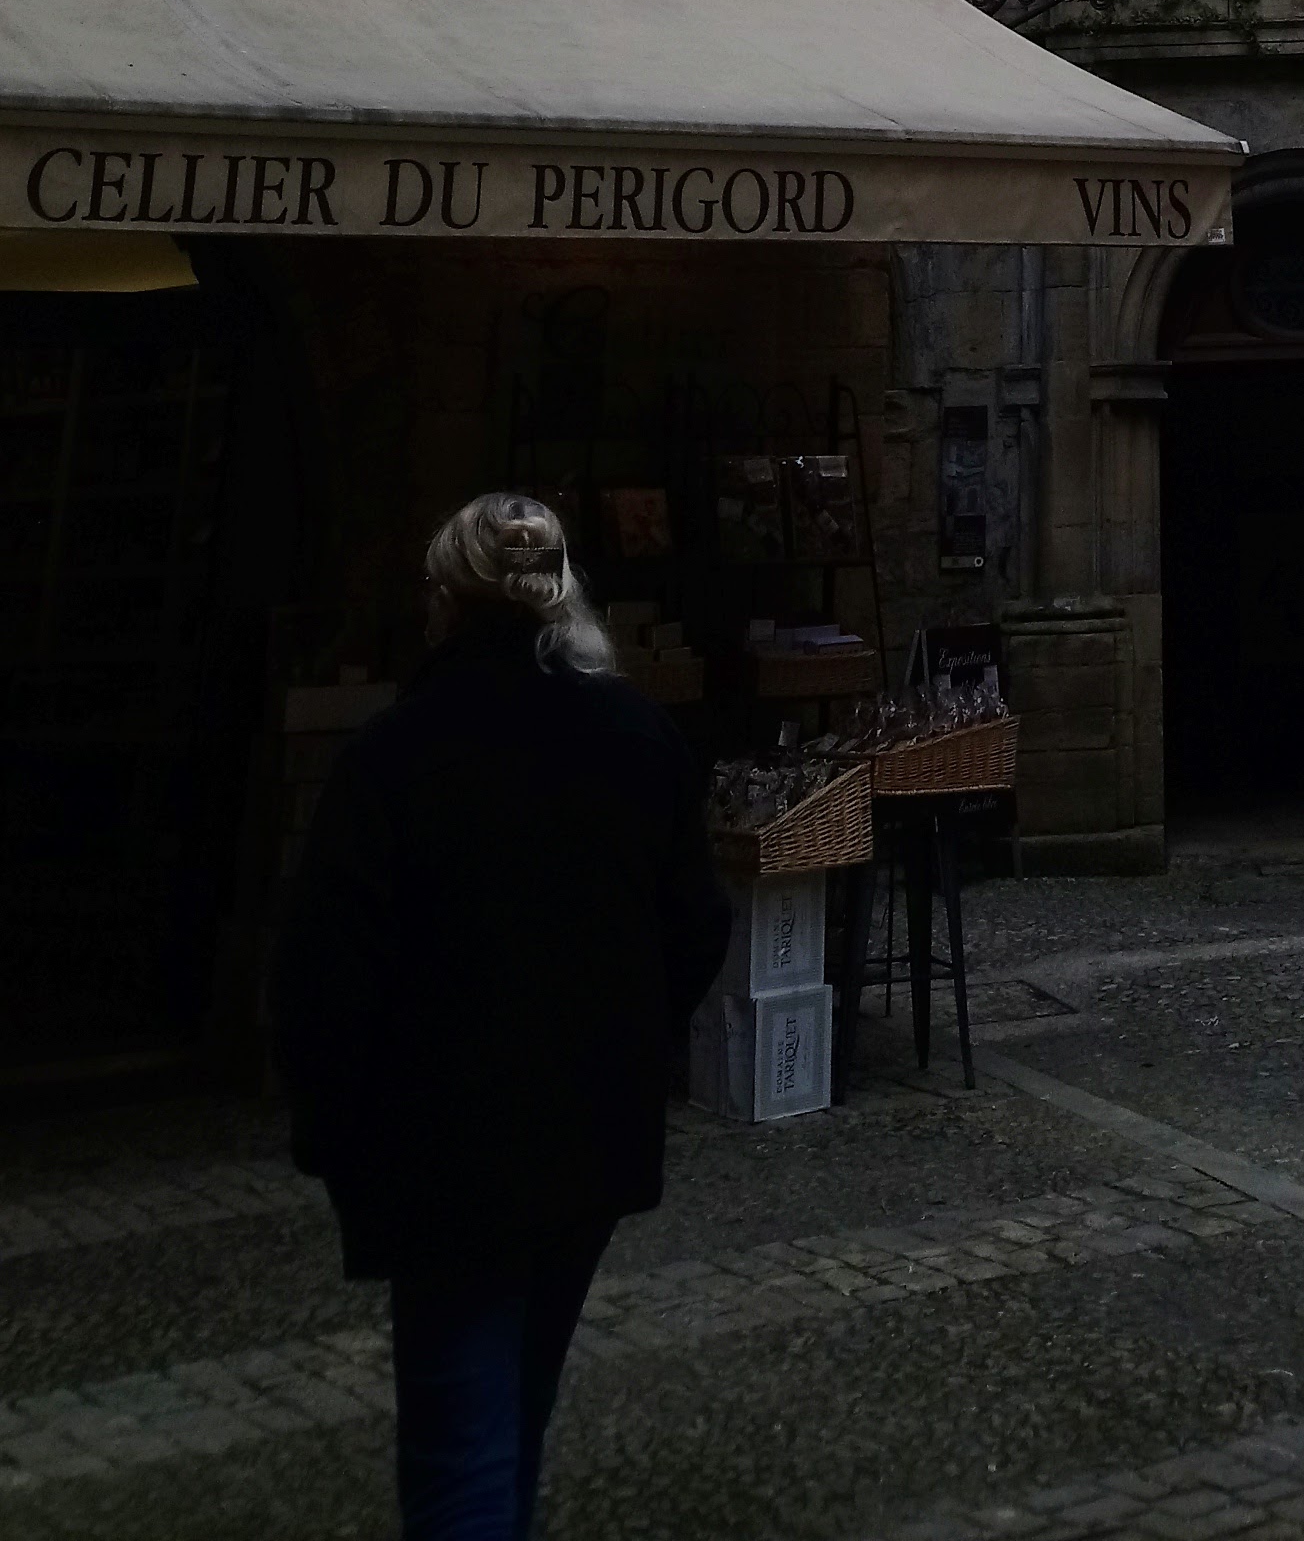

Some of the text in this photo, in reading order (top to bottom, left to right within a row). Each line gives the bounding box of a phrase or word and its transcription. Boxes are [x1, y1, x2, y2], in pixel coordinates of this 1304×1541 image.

[26, 147, 855, 234] CELLIER DU PERIGORD
[1073, 177, 1191, 240] VINS
[781, 895, 796, 968] TARIQUET
[784, 1017, 800, 1092] TARIQUET
